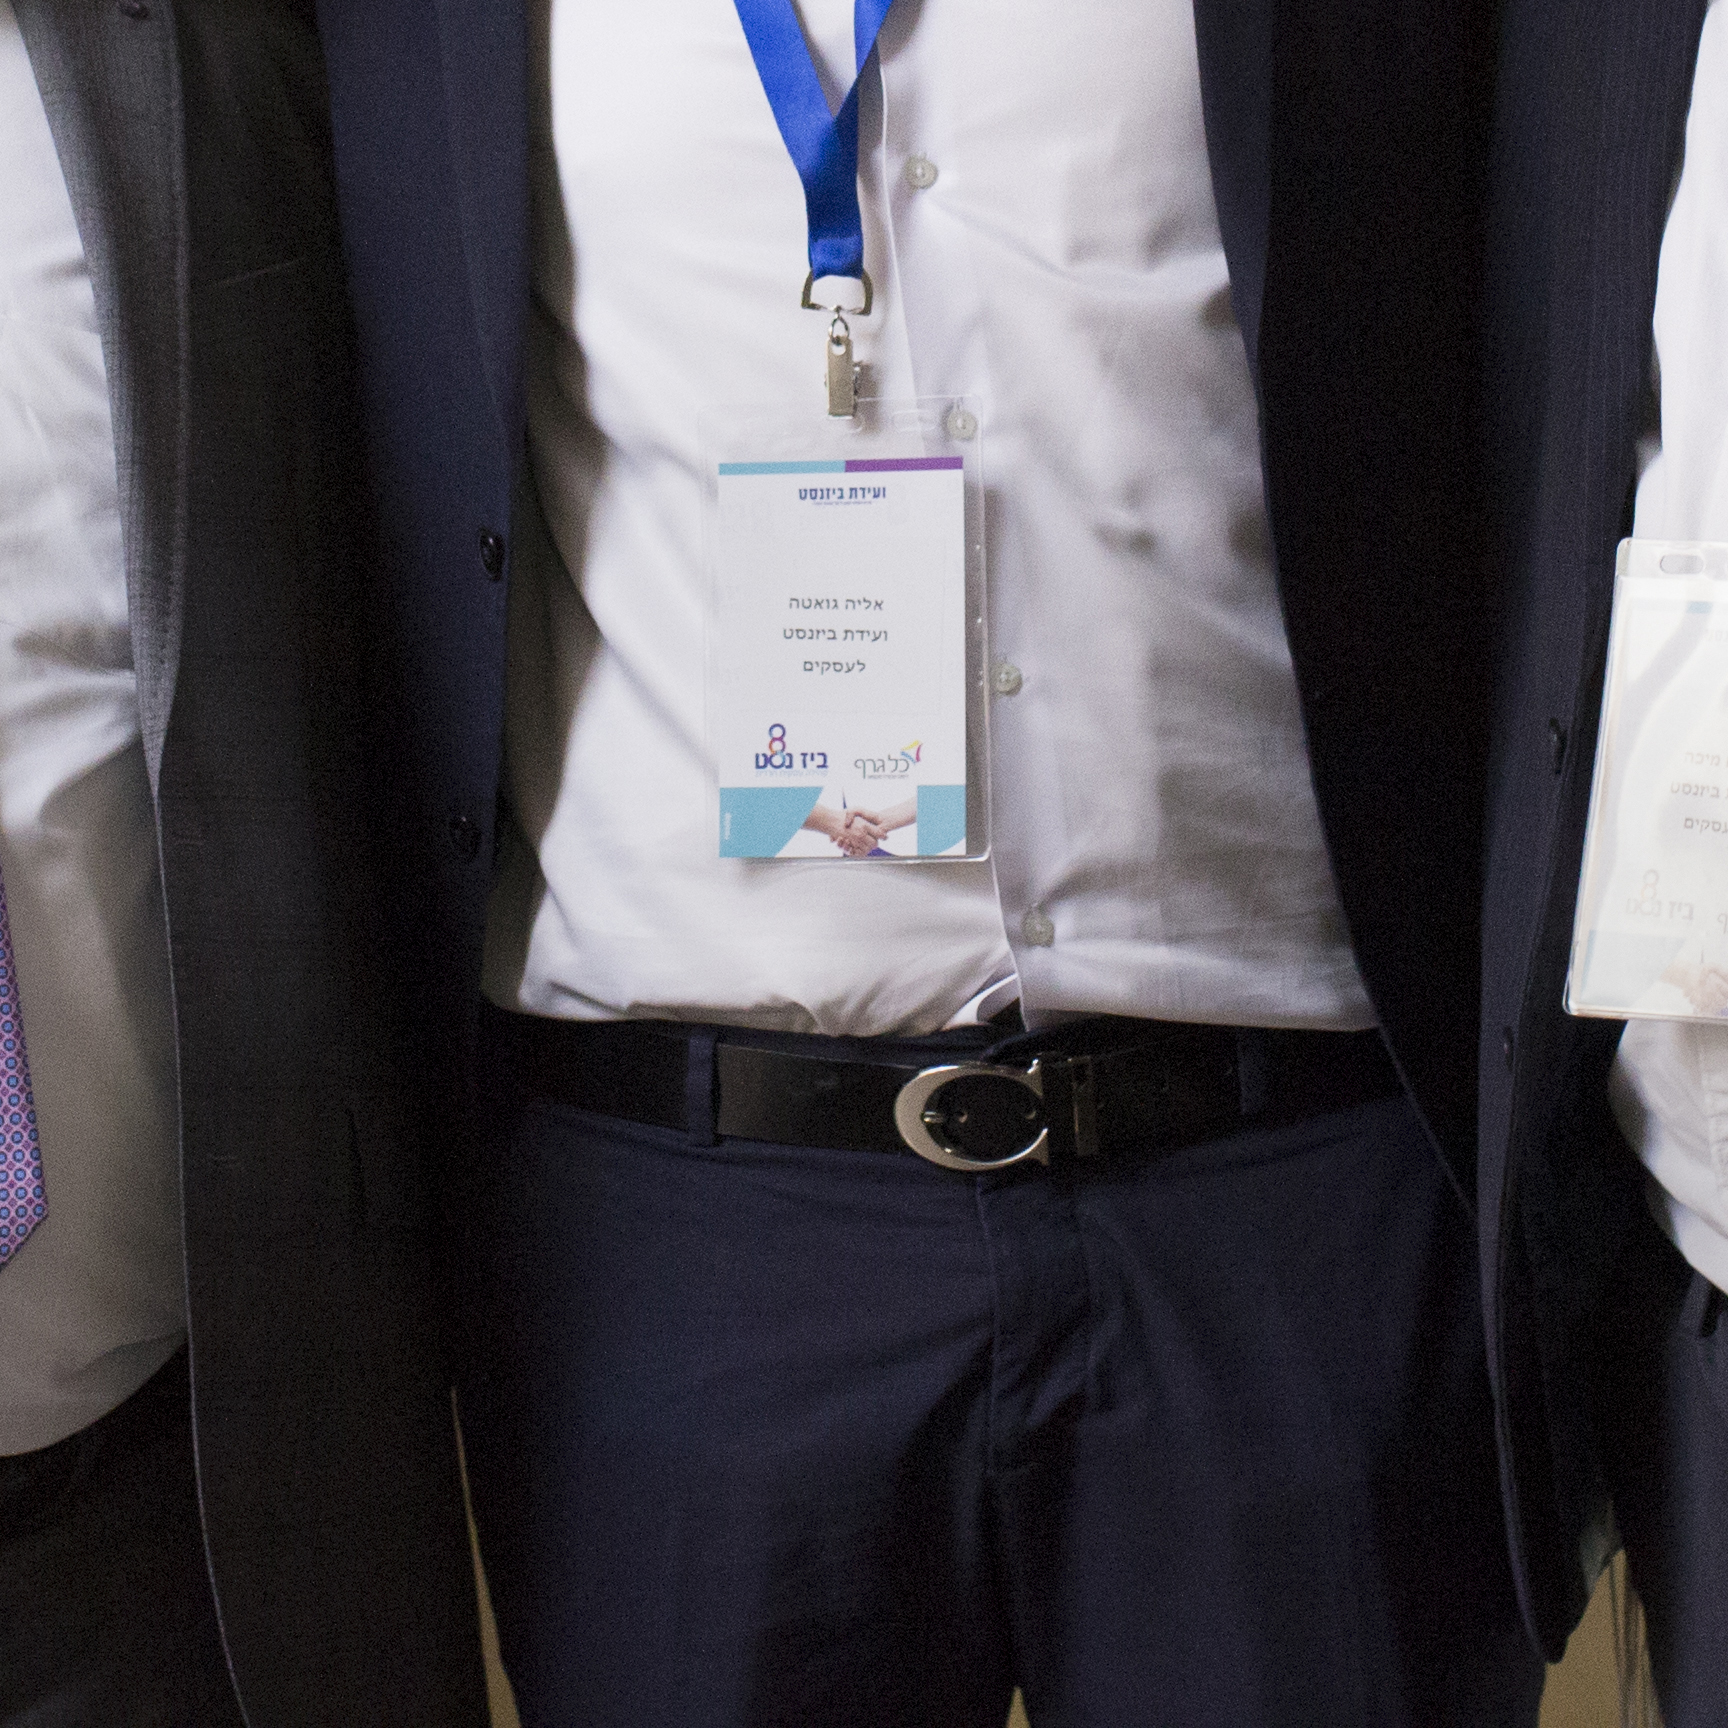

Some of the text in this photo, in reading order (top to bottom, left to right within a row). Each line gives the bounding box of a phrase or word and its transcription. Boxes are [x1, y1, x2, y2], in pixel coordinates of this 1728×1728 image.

[798, 487, 887, 500] ועידת ביזנסט
[789, 597, 884, 610] אליה גואטה
[783, 628, 888, 642] ועידת ביזנסט
[802, 659, 866, 675] לעסקים
[800, 752, 828, 769] ביז
[1670, 782, 1720, 798] ביזנסט
